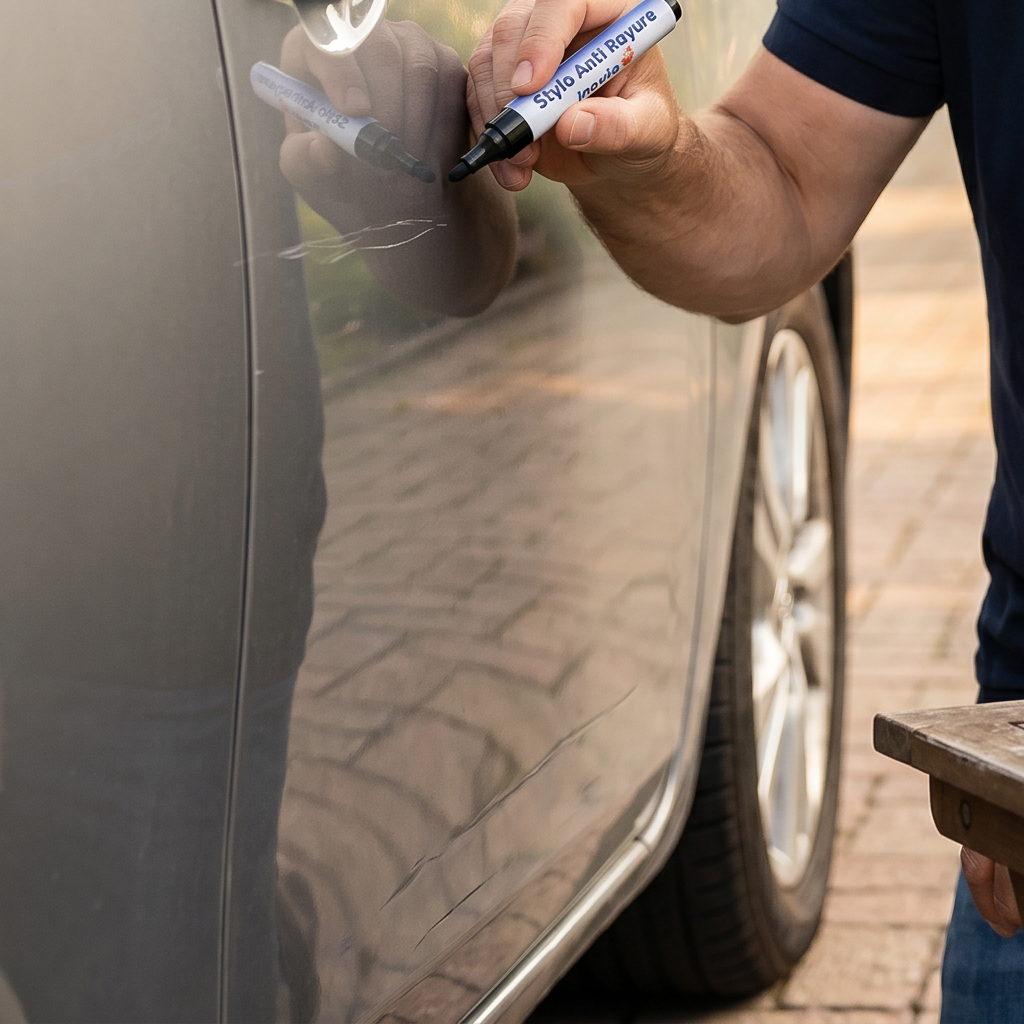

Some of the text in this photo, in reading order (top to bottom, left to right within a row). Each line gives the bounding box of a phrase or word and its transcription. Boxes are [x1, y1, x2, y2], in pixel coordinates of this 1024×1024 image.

[533, 10, 657, 109] Stylo Anti Rayure
